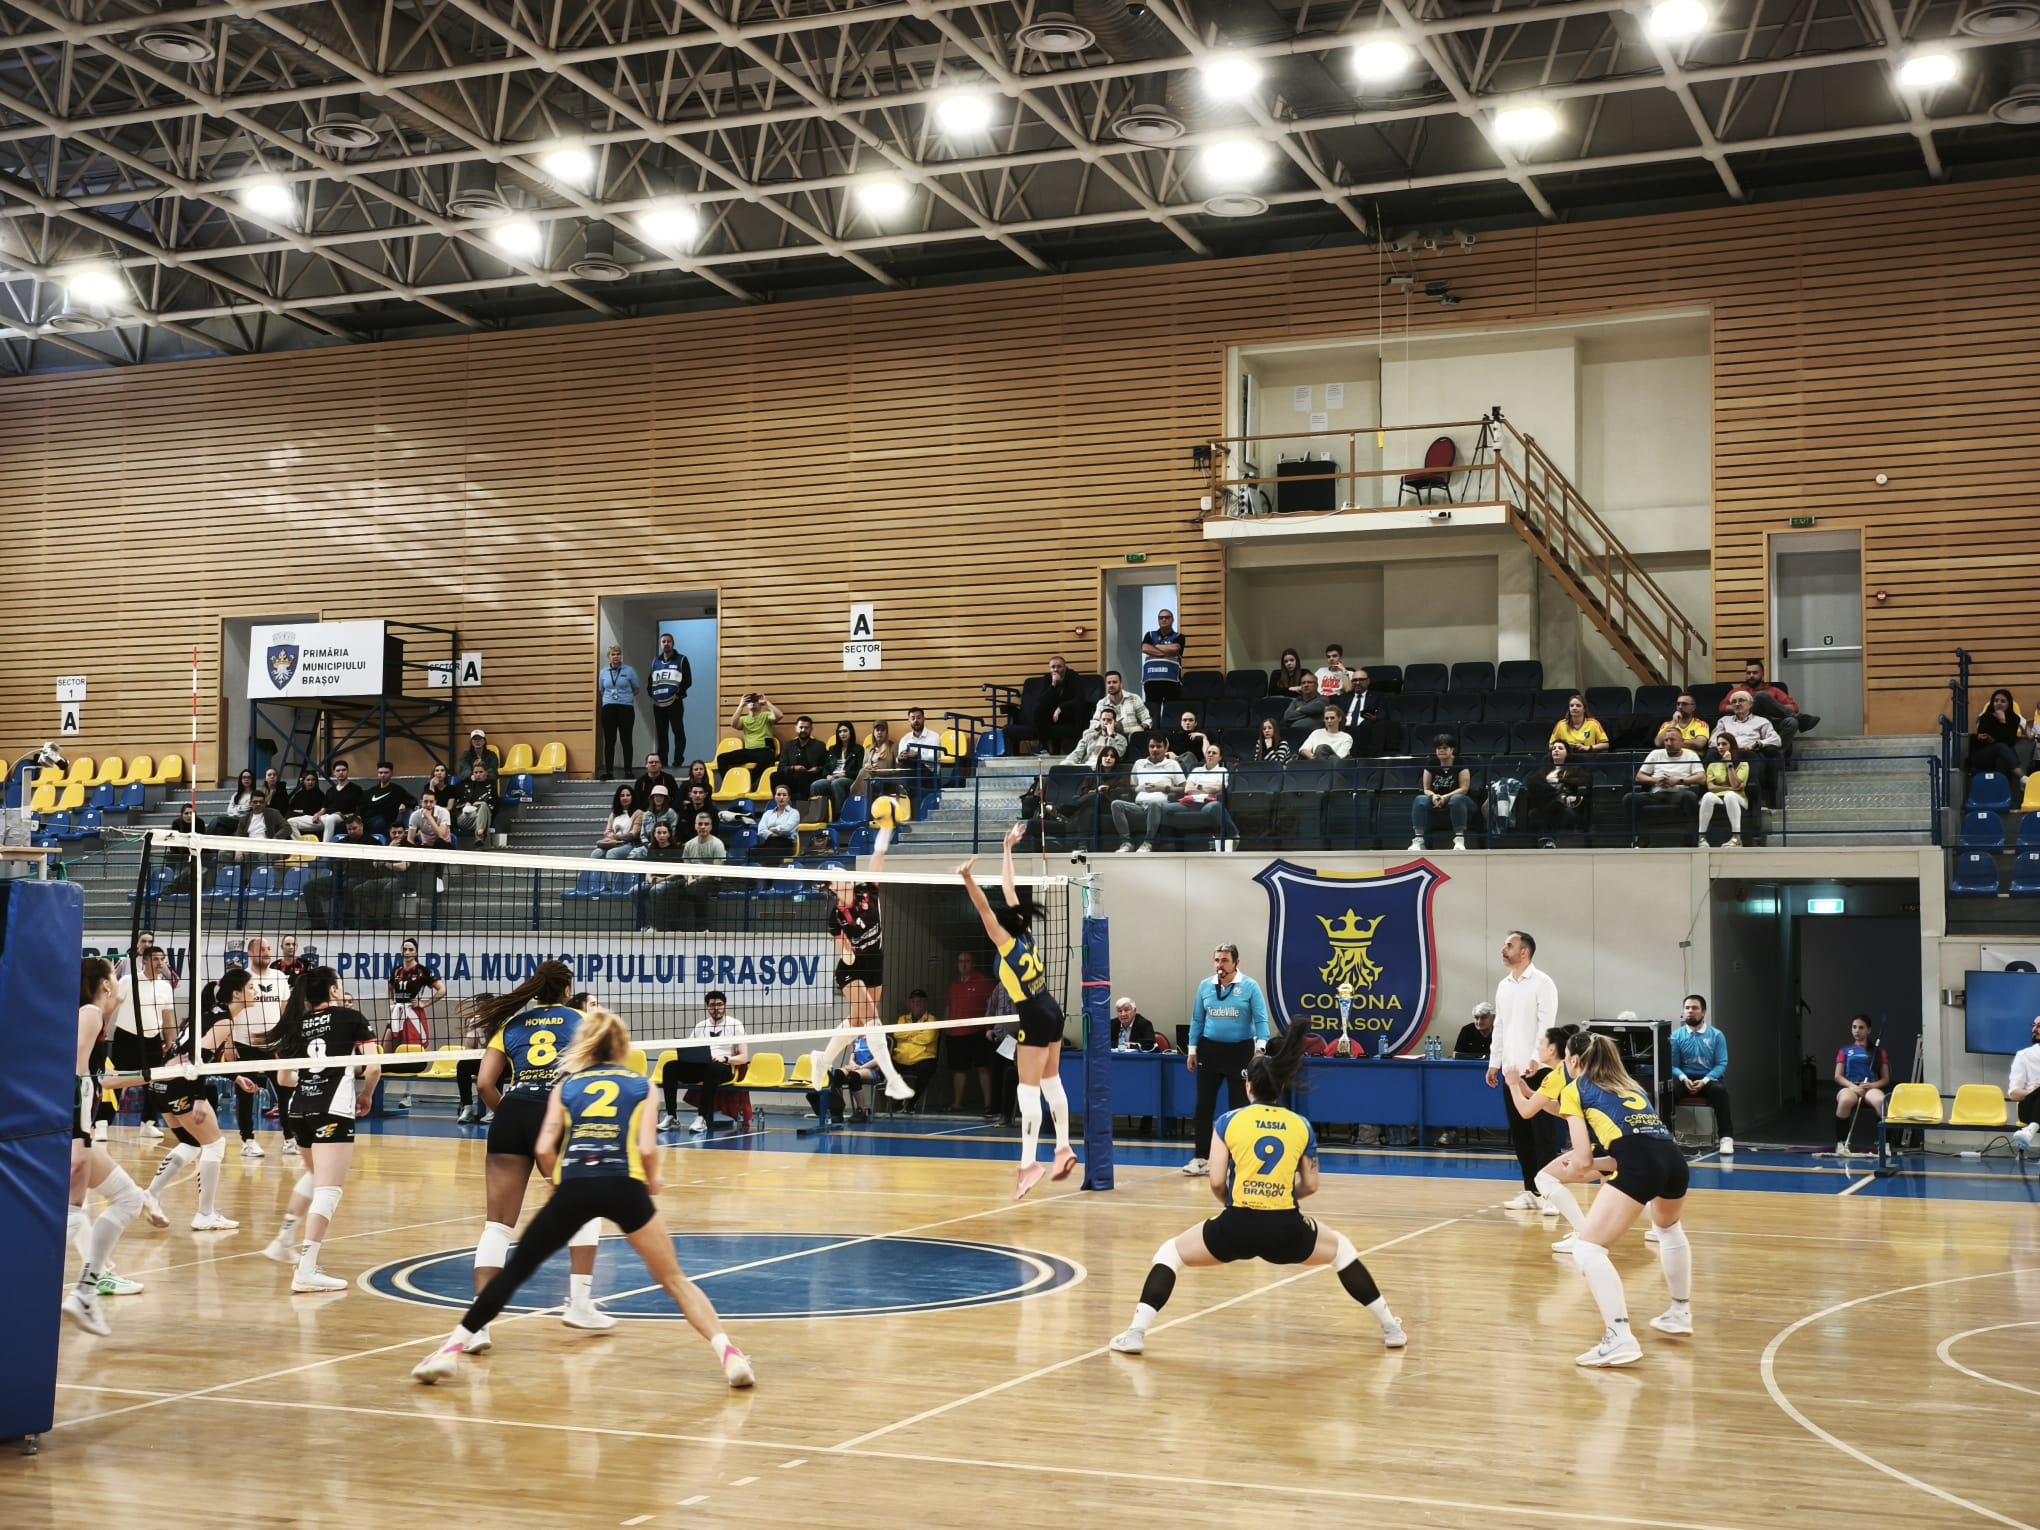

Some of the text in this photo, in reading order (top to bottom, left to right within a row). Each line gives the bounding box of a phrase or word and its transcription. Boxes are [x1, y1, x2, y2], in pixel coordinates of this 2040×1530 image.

[854, 613, 871, 635] A
[303, 646, 349, 658] PRIMĂRIA
[844, 644, 881, 654] SECTOR
[302, 660, 366, 672] MUNICIPIULUI
[858, 656, 866, 667] 3
[463, 660, 479, 682] A
[57, 678, 86, 687] SECTOR
[301, 674, 341, 686] BRAȘOV
[441, 673, 448, 685] 2
[69, 688, 73, 699] 1
[63, 711, 77, 731] A
[337, 951, 820, 996] PRIMRIA MUNIPIULUI BRAȘOV
[1208, 1006, 1240, 1018] TradeVille
[525, 1016, 564, 1027] HOWARD
[527, 1030, 557, 1066] 8
[580, 1080, 620, 1117] 2
[1255, 1120, 1286, 1130] TASSIA
[1254, 1135, 1284, 1175] 9
[1242, 1180, 1286, 1191] CORONA
